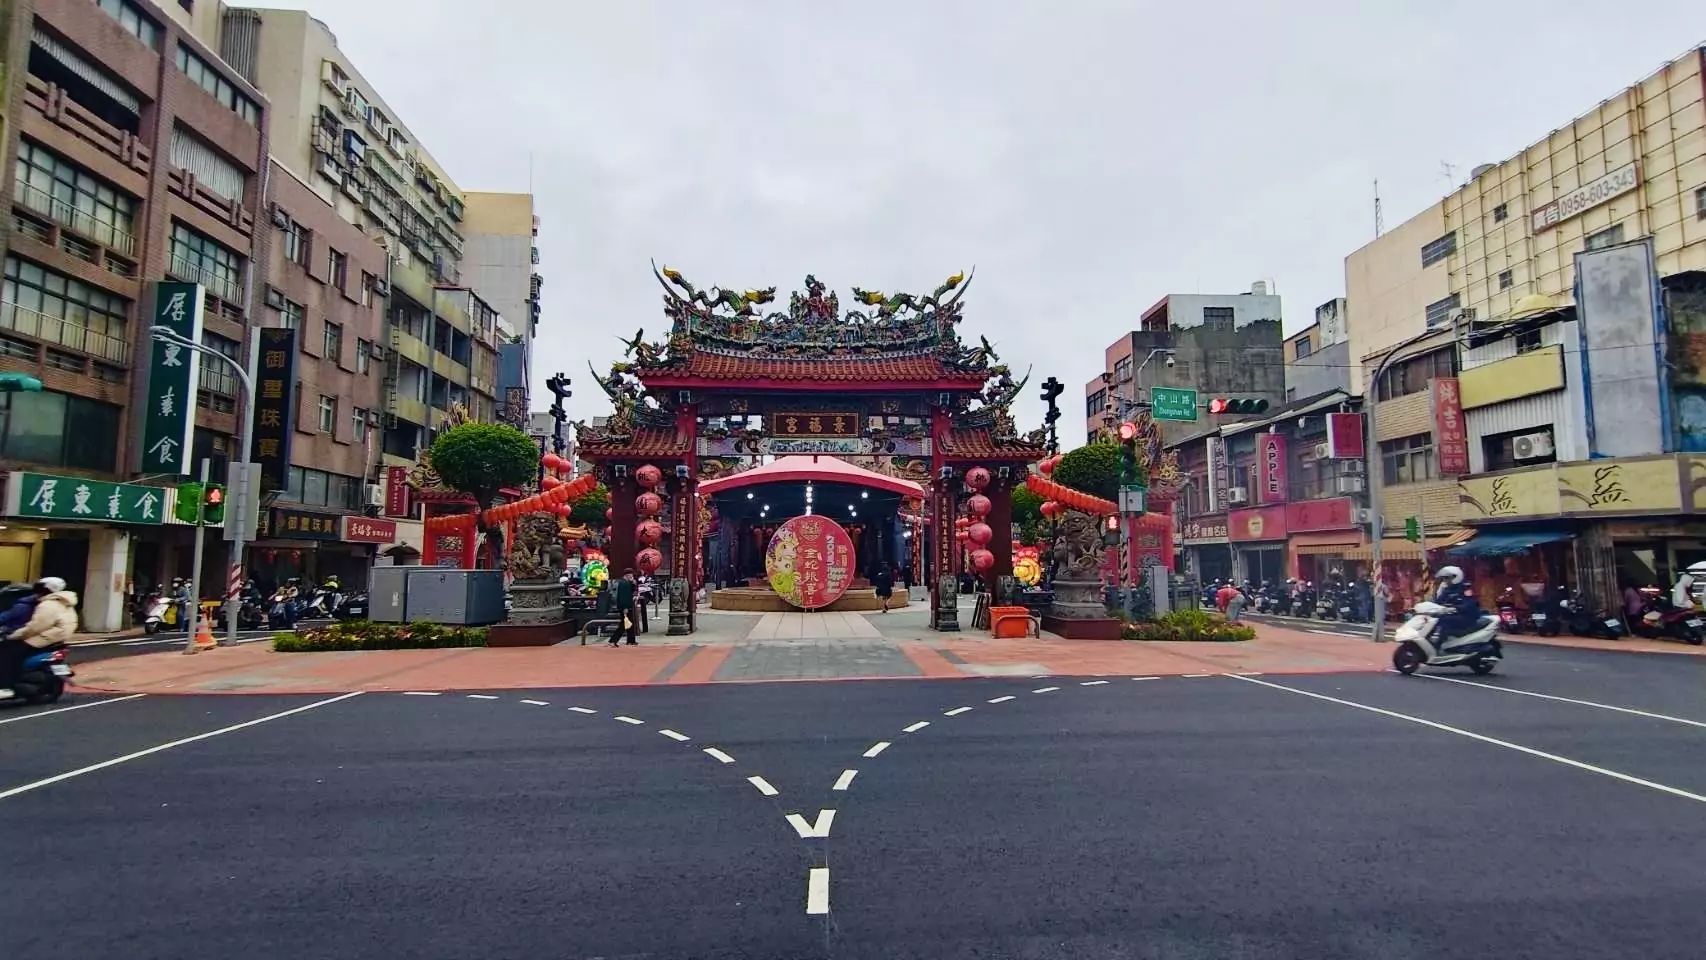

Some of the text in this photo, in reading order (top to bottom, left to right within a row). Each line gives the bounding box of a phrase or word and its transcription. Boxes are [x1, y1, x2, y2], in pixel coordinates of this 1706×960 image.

[1561, 168, 1635, 216] 0958-603-343
[1157, 392, 1190, 405] 中山路
[1268, 441, 1279, 493] APPLE
